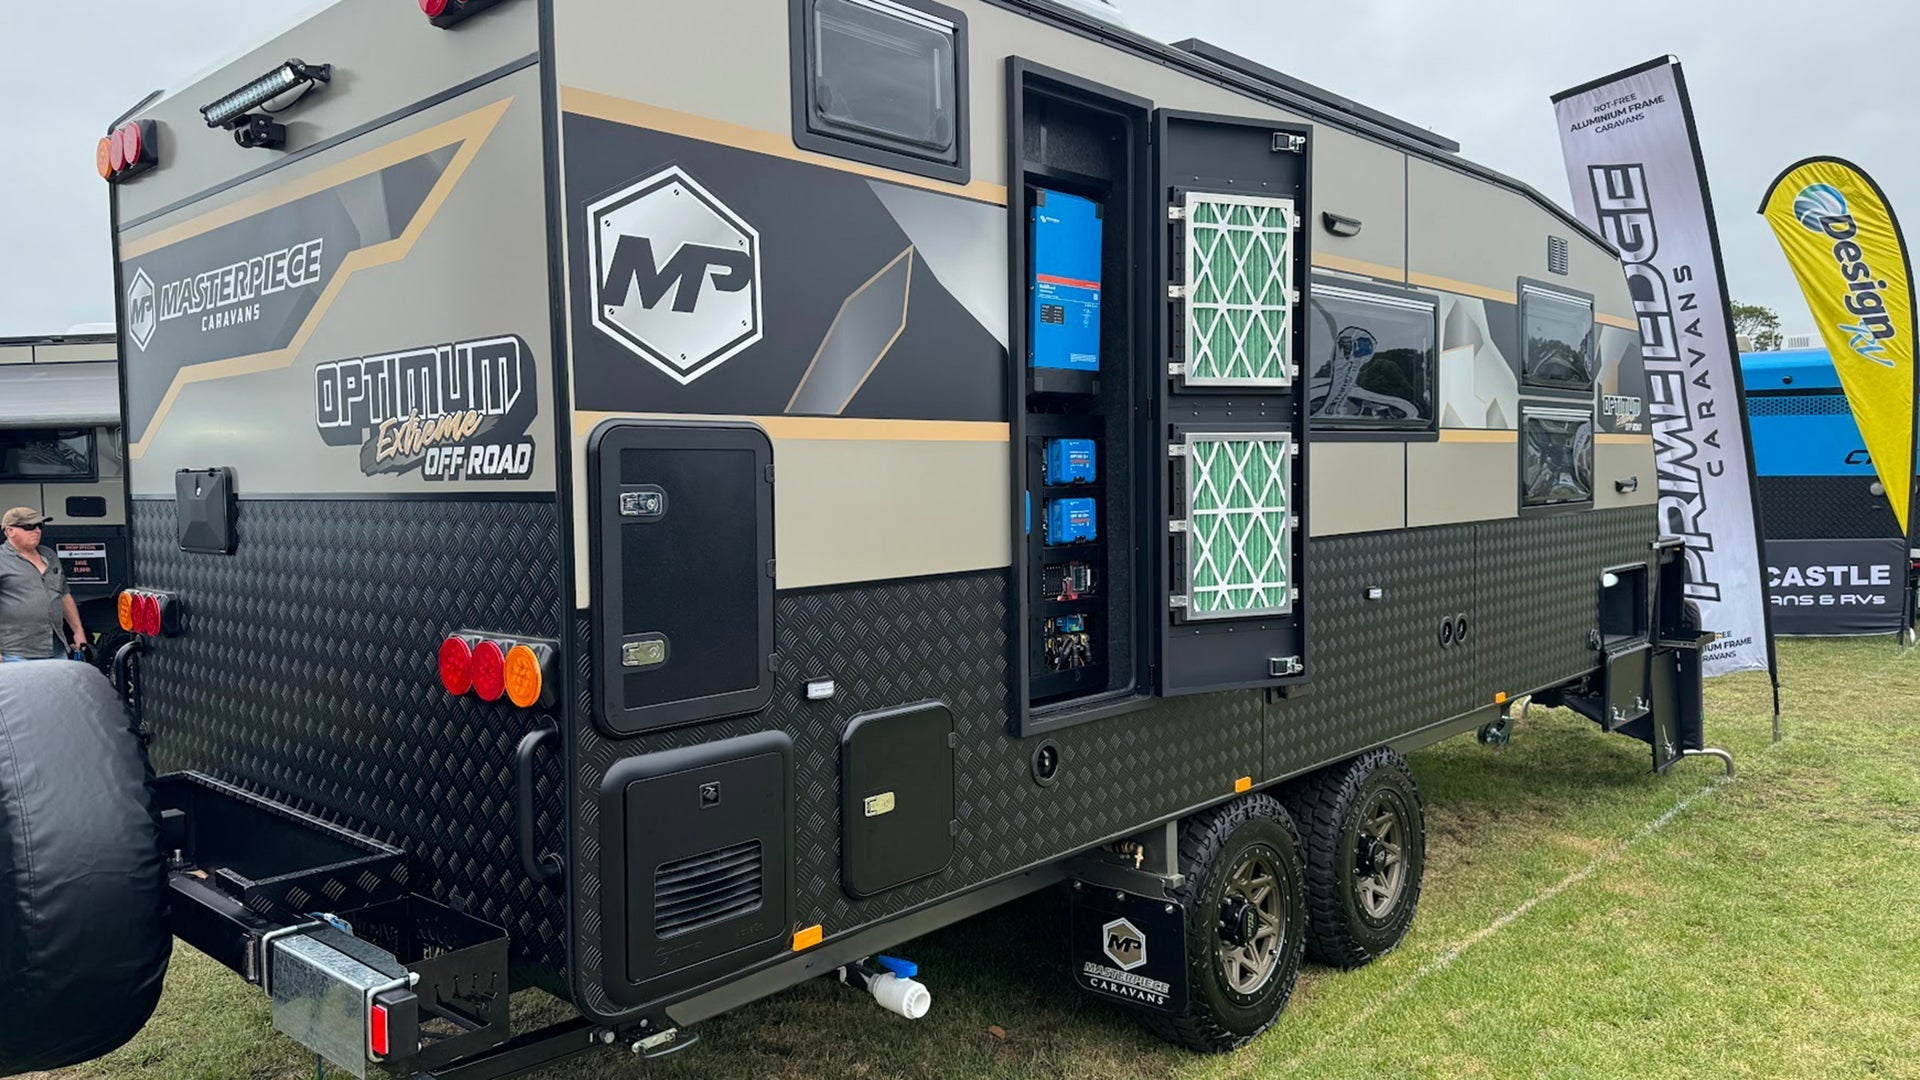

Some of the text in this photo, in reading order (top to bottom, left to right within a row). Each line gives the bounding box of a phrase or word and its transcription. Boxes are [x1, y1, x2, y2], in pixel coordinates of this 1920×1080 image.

[1570, 94, 1665, 132] ALUMINIUM FRAME
[1593, 92, 1637, 113] ROT-FREE
[1594, 112, 1645, 134] CARAVANS
[159, 237, 324, 322] MASTERPIECE
[603, 234, 751, 313] MP
[1818, 214, 1895, 341] Design
[201, 303, 260, 332] CARAVANS
[315, 335, 522, 428] OPTIMUM
[1673, 264, 1725, 477] CARAVANS
[375, 407, 484, 463] Extreme
[424, 442, 532, 475] OFF ROAD
[1819, 594, 1835, 605] &
[1723, 636, 1753, 650] FRAME
[1107, 933, 1142, 953] MP
[1083, 961, 1170, 994] MASTERPIECE
[1090, 978, 1164, 1005] CARAVANS
